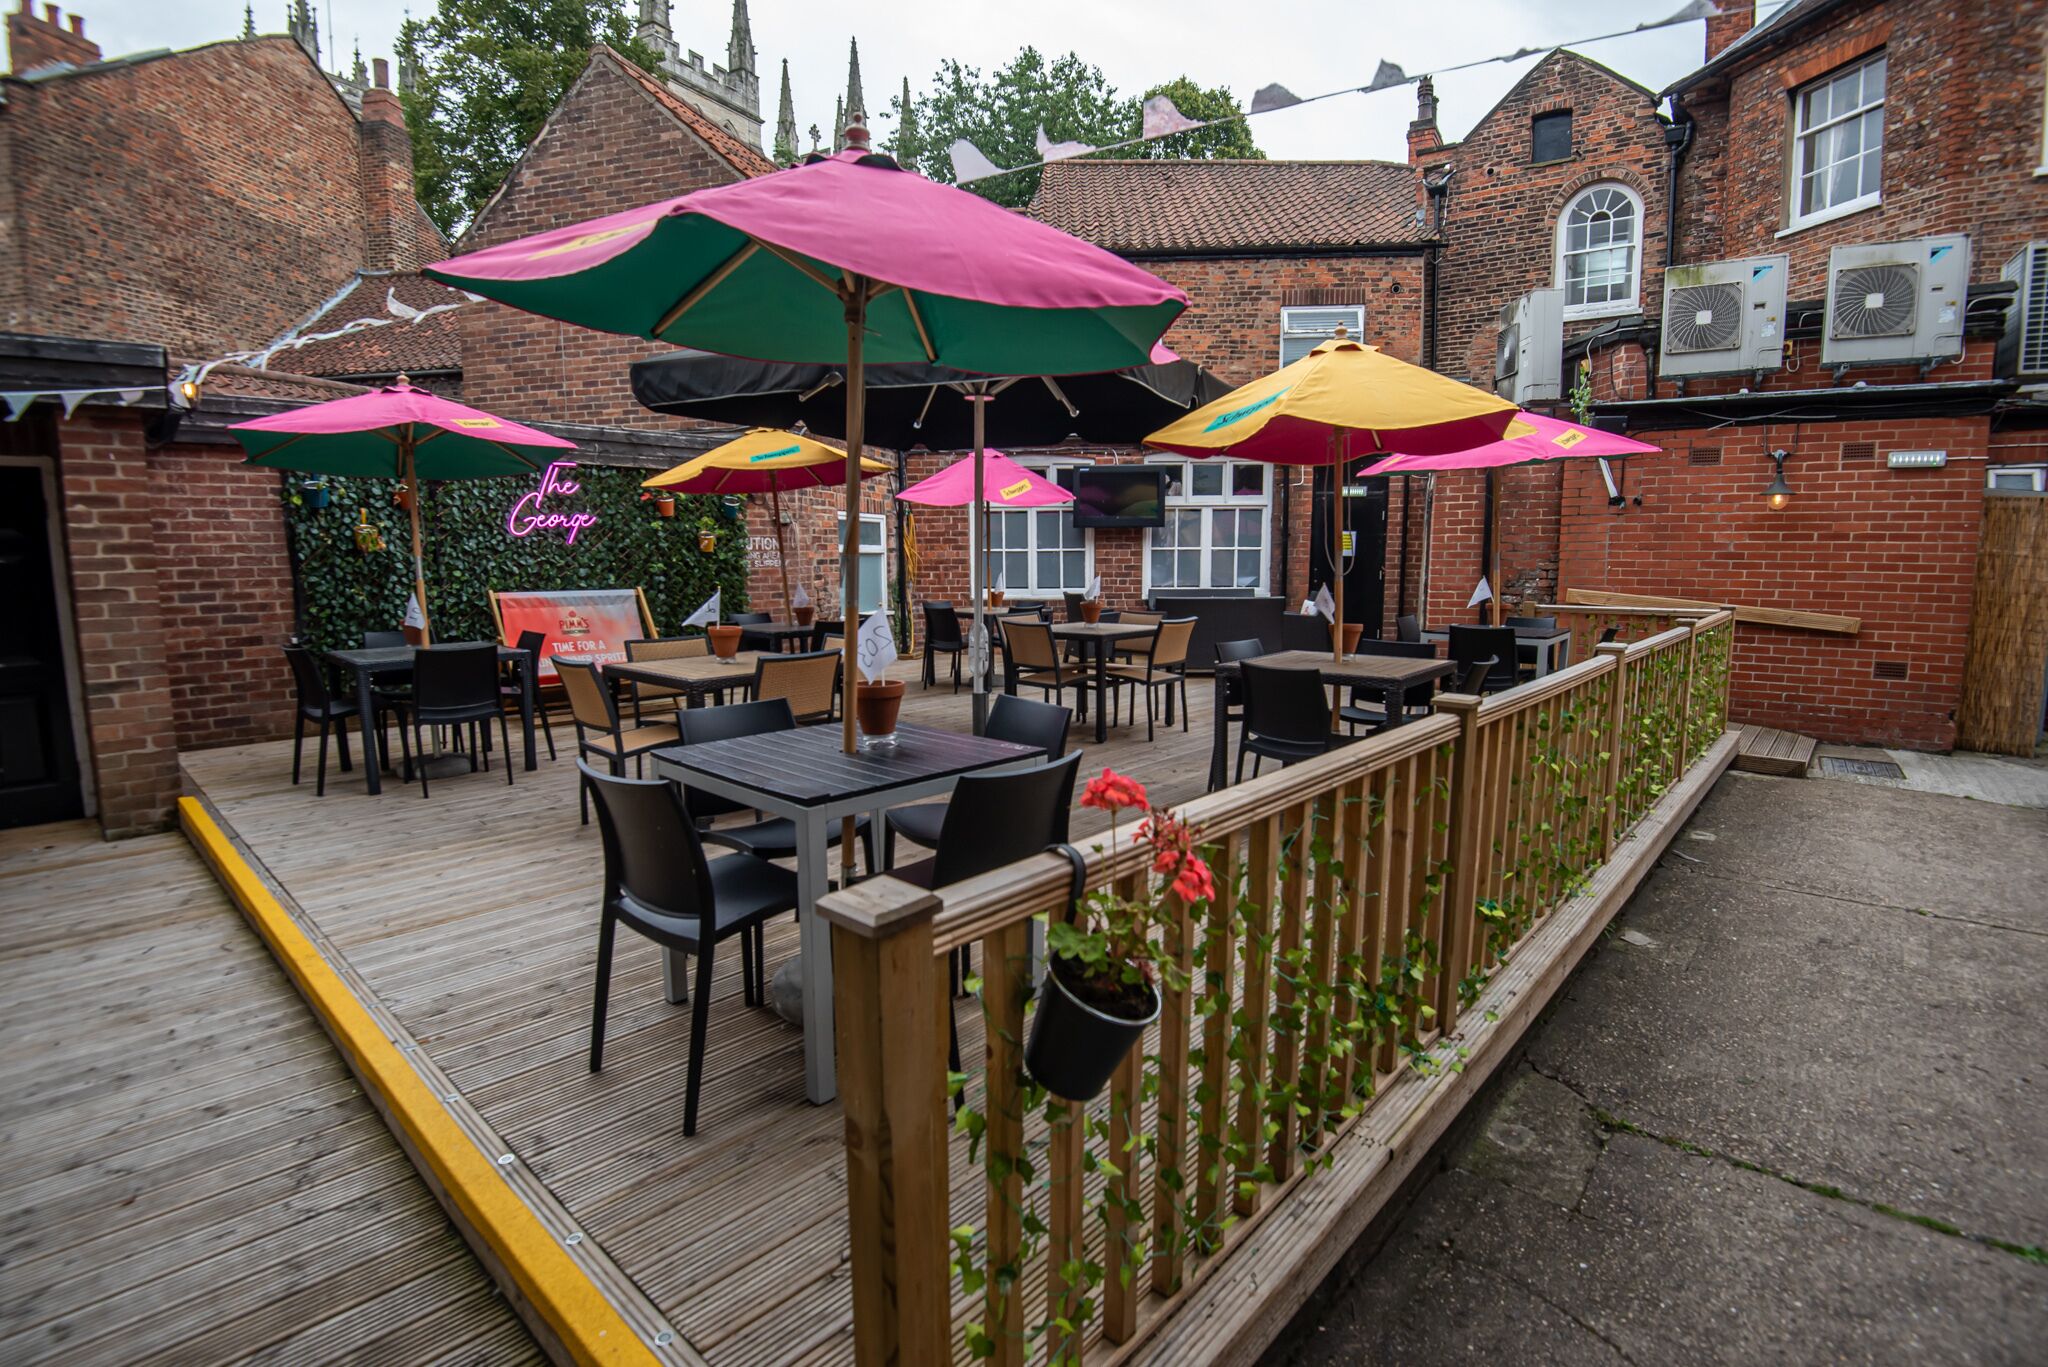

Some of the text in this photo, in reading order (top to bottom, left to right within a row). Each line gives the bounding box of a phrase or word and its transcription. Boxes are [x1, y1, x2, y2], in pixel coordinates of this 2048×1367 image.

[537, 462, 579, 508] The
[509, 492, 597, 544] George
[745, 537, 780, 550] UTION
[552, 640, 607, 653] TIME FOR A
